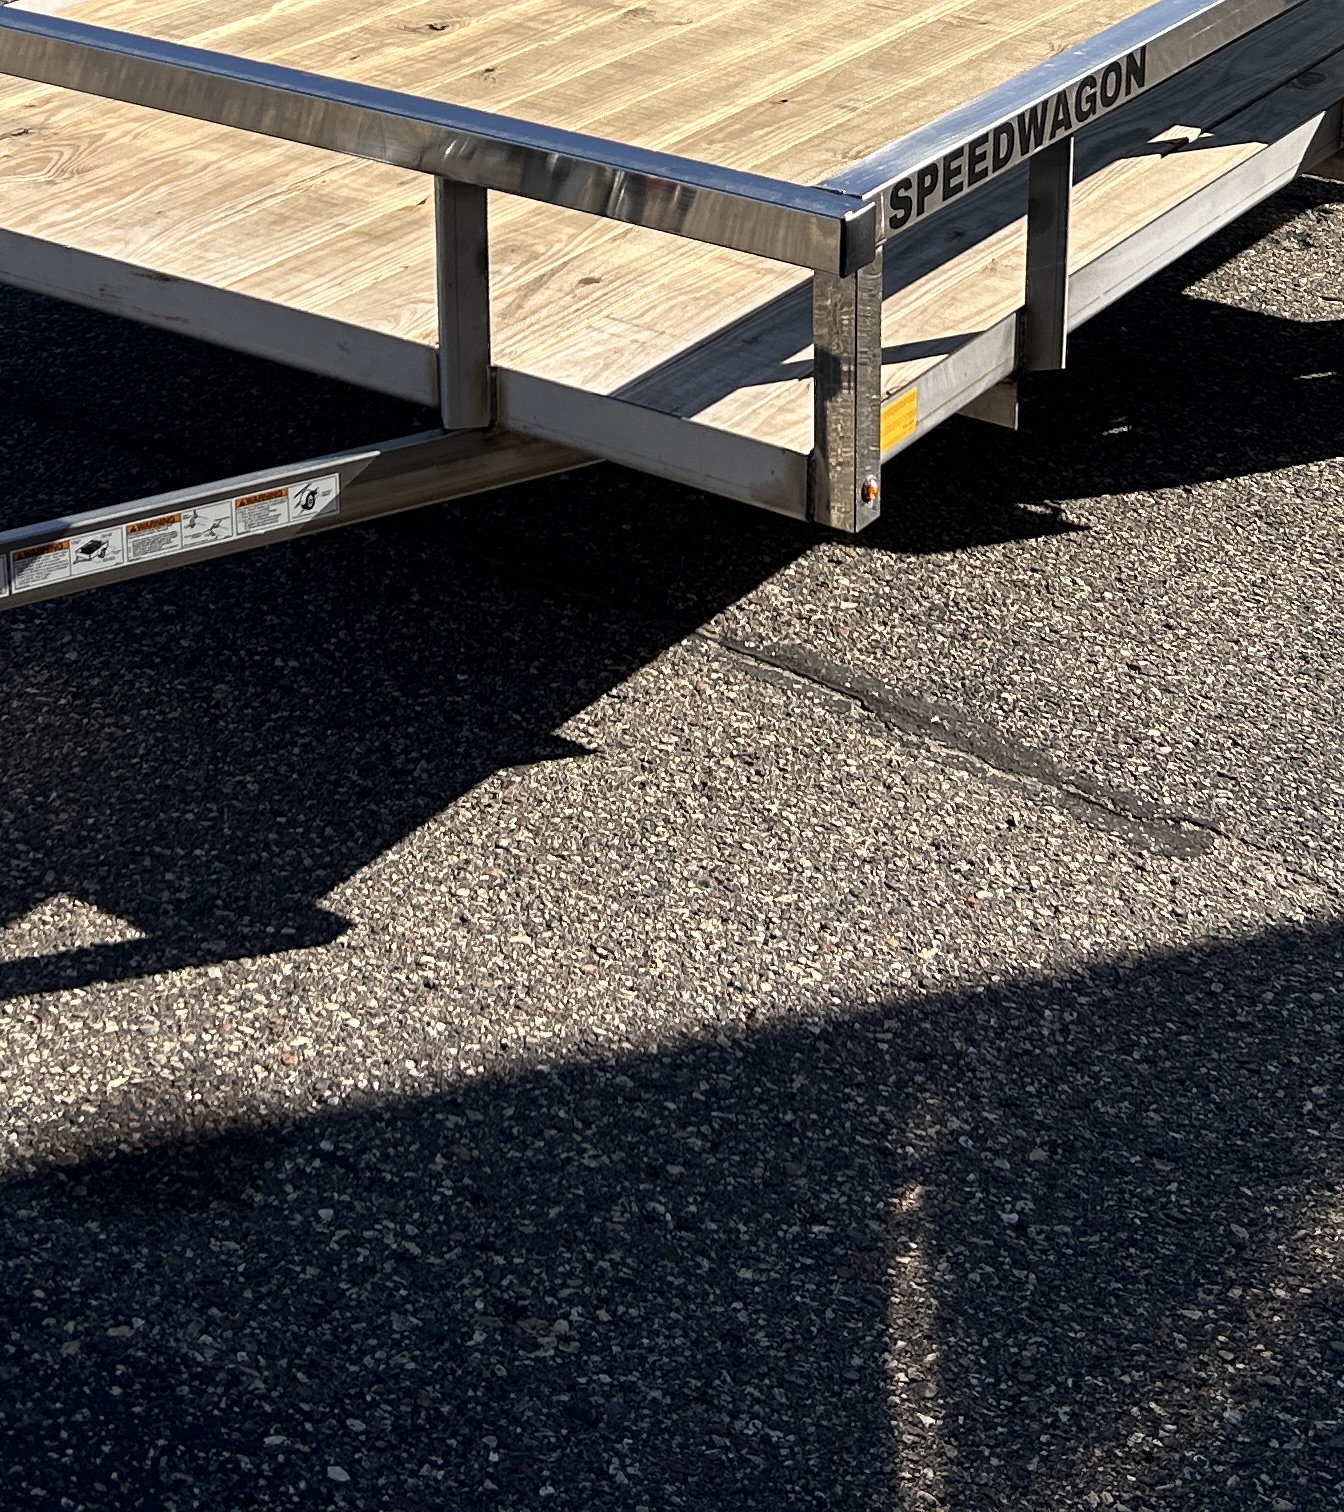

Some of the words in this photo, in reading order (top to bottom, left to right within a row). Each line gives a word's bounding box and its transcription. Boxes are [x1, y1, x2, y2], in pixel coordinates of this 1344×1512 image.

[889, 45, 1146, 230] SPEEDWAGON
[246, 489, 284, 505] WARNING
[137, 515, 176, 531] WARNING
